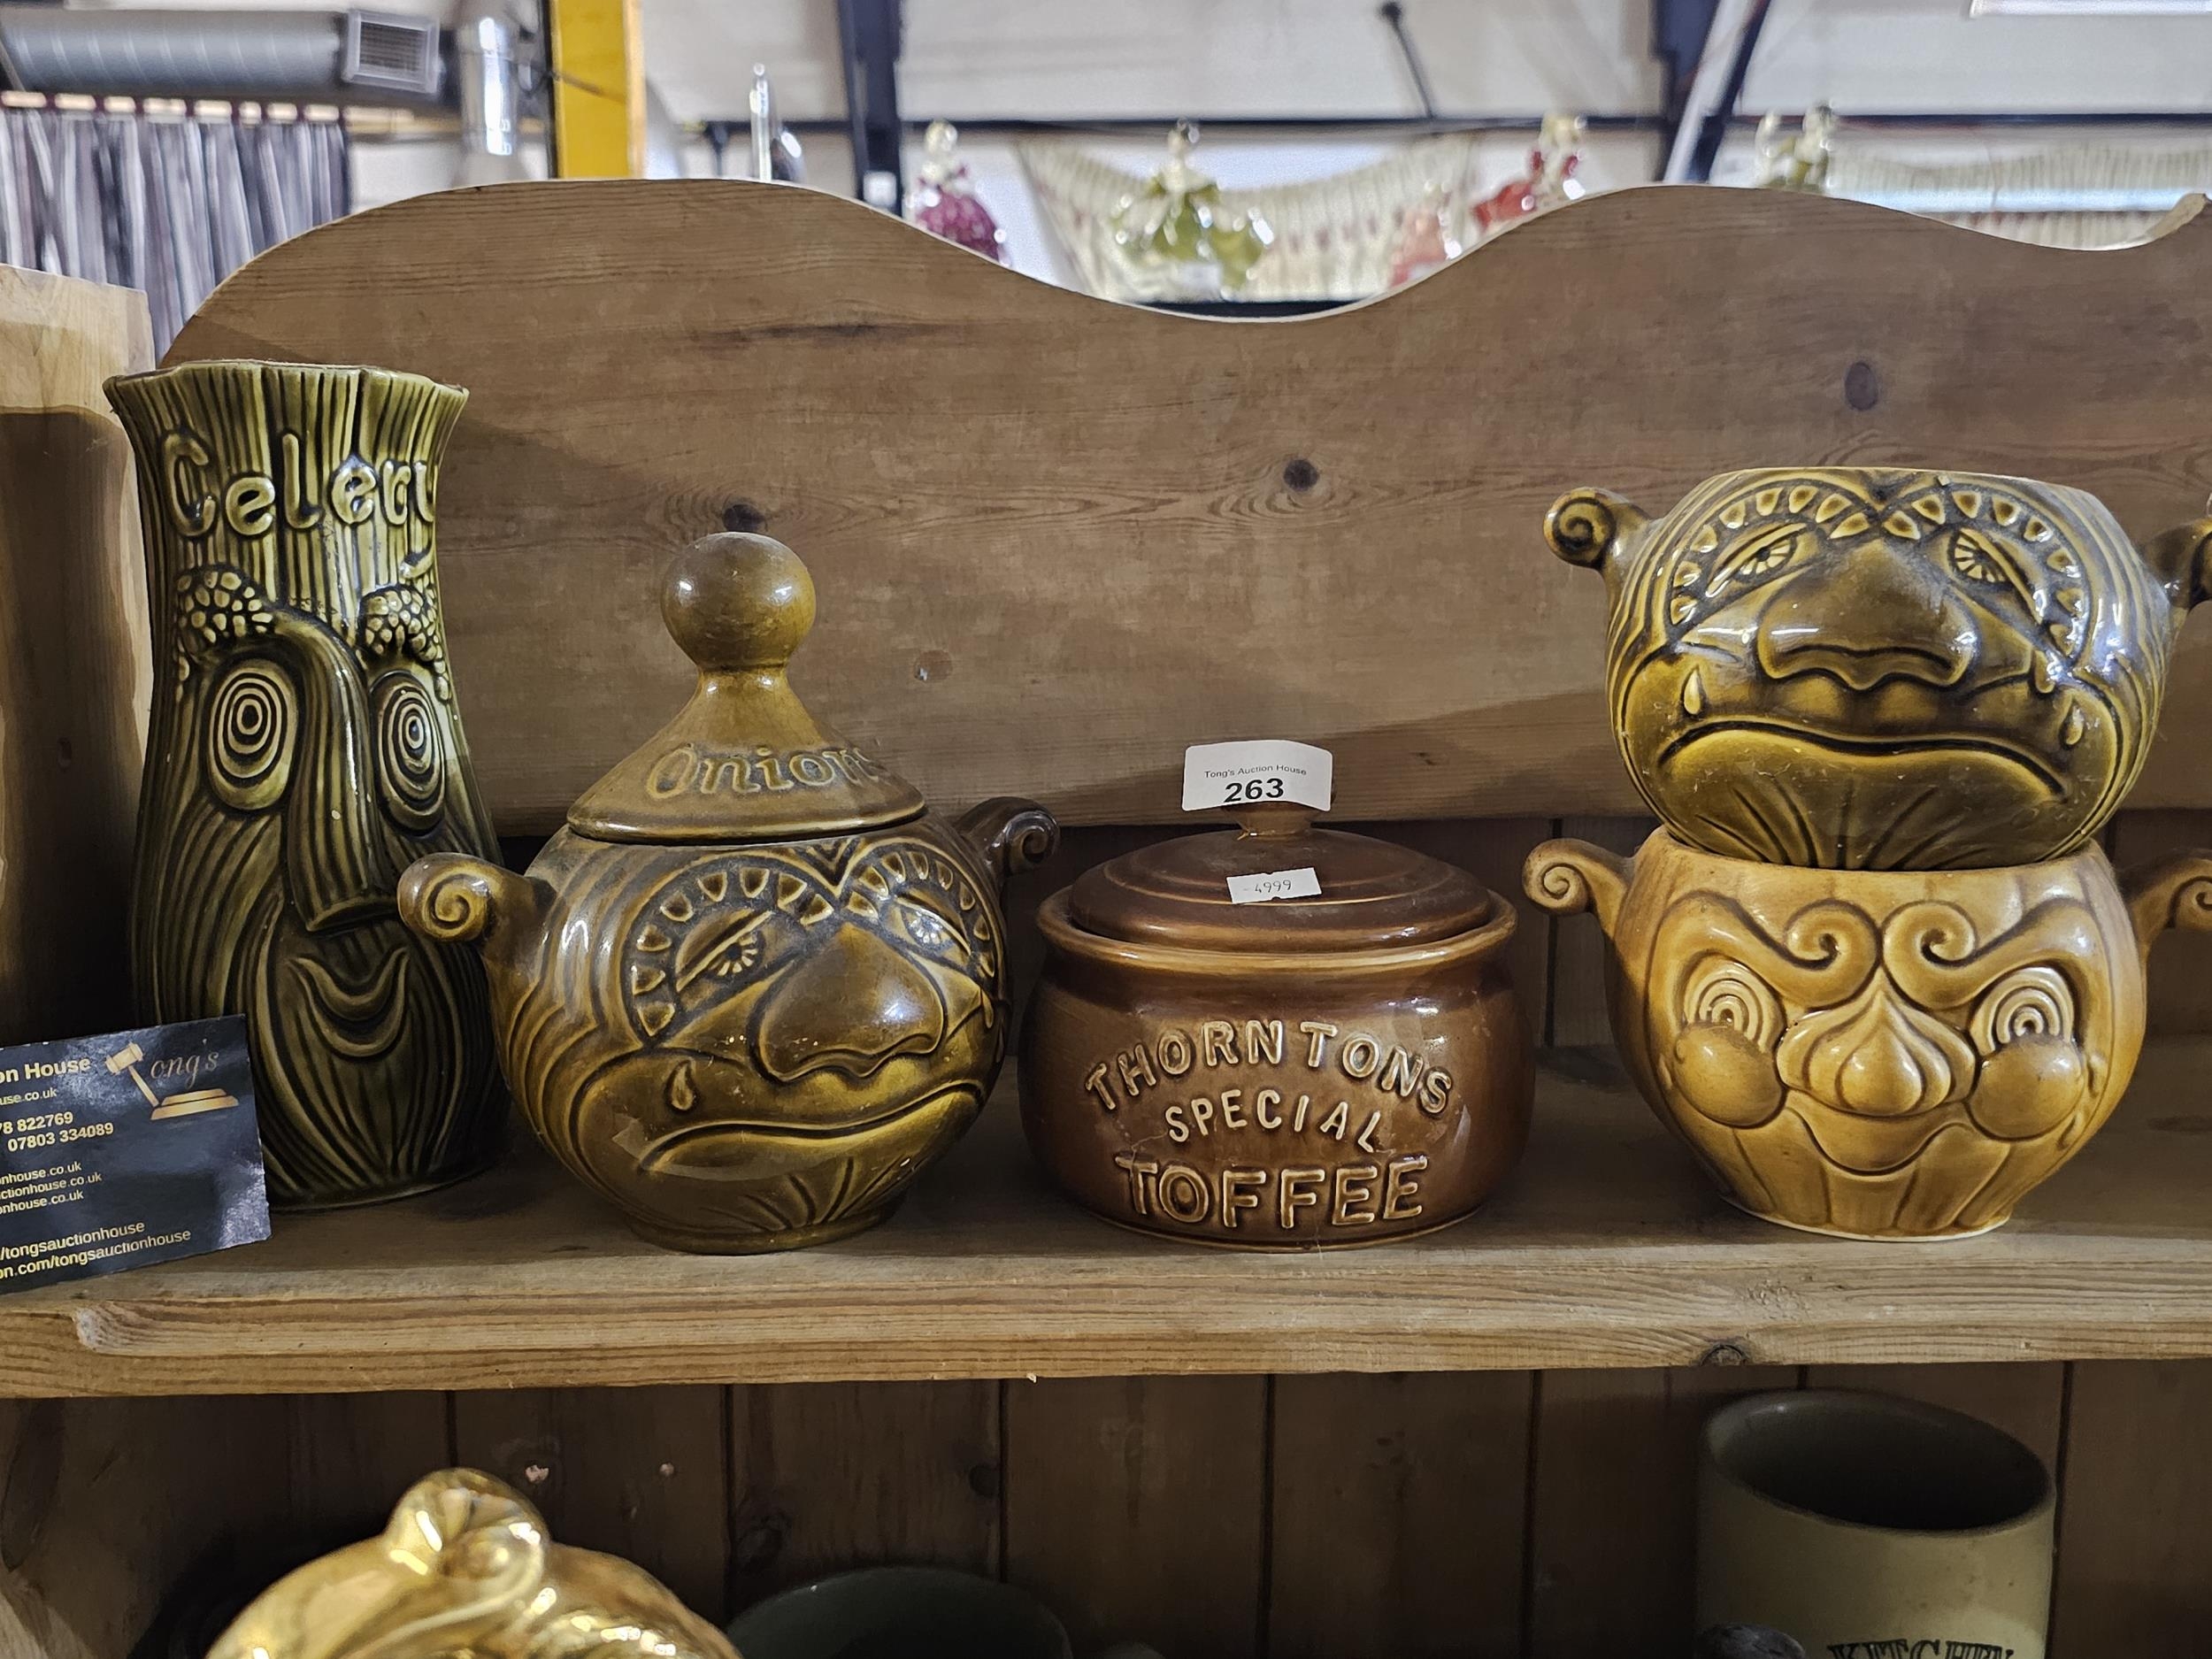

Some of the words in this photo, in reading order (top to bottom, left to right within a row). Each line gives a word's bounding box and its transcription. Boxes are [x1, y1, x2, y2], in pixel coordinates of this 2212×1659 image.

[1204, 769, 1235, 778] Tong's
[1238, 765, 1273, 775] Auction
[1276, 764, 1307, 775] House
[1224, 778, 1284, 803] 263
[1255, 879, 1292, 893] 4999
[25, 1058, 90, 1079] House
[0, 1121, 13, 1134] 8
[17, 1111, 73, 1132] 822769
[1164, 1089, 1382, 1153] SPECIAL
[8, 1132, 56, 1152] 07803
[59, 1122, 114, 1142] 334089
[0, 1161, 82, 1185] nhouse.co.uk
[0, 1171, 102, 1200] ctionhouse.co.uk
[1115, 1155, 1428, 1228] TOFFEE
